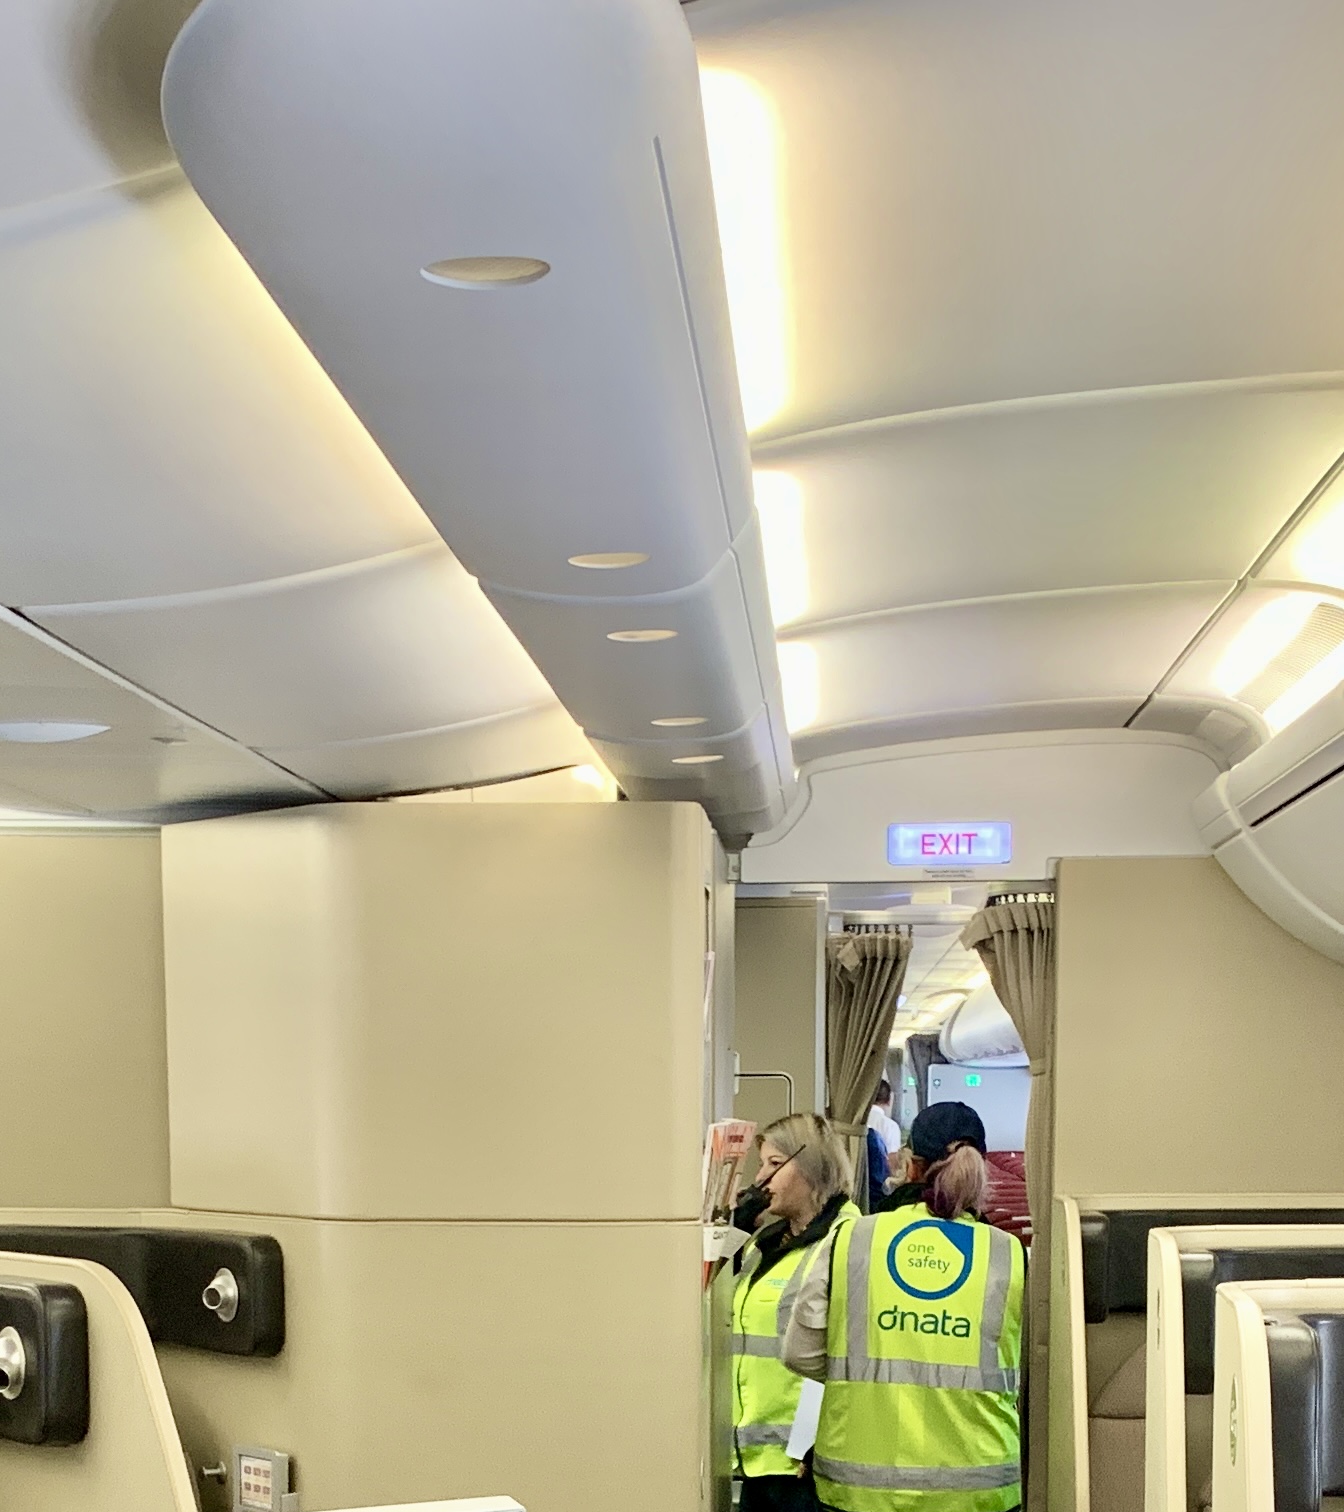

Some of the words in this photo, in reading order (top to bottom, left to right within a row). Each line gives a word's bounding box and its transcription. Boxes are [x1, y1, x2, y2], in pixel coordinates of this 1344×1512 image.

[921, 833, 978, 855] EXIT
[907, 1243, 935, 1254] one
[907, 1255, 951, 1274] safety
[877, 1305, 971, 1338] dnata
